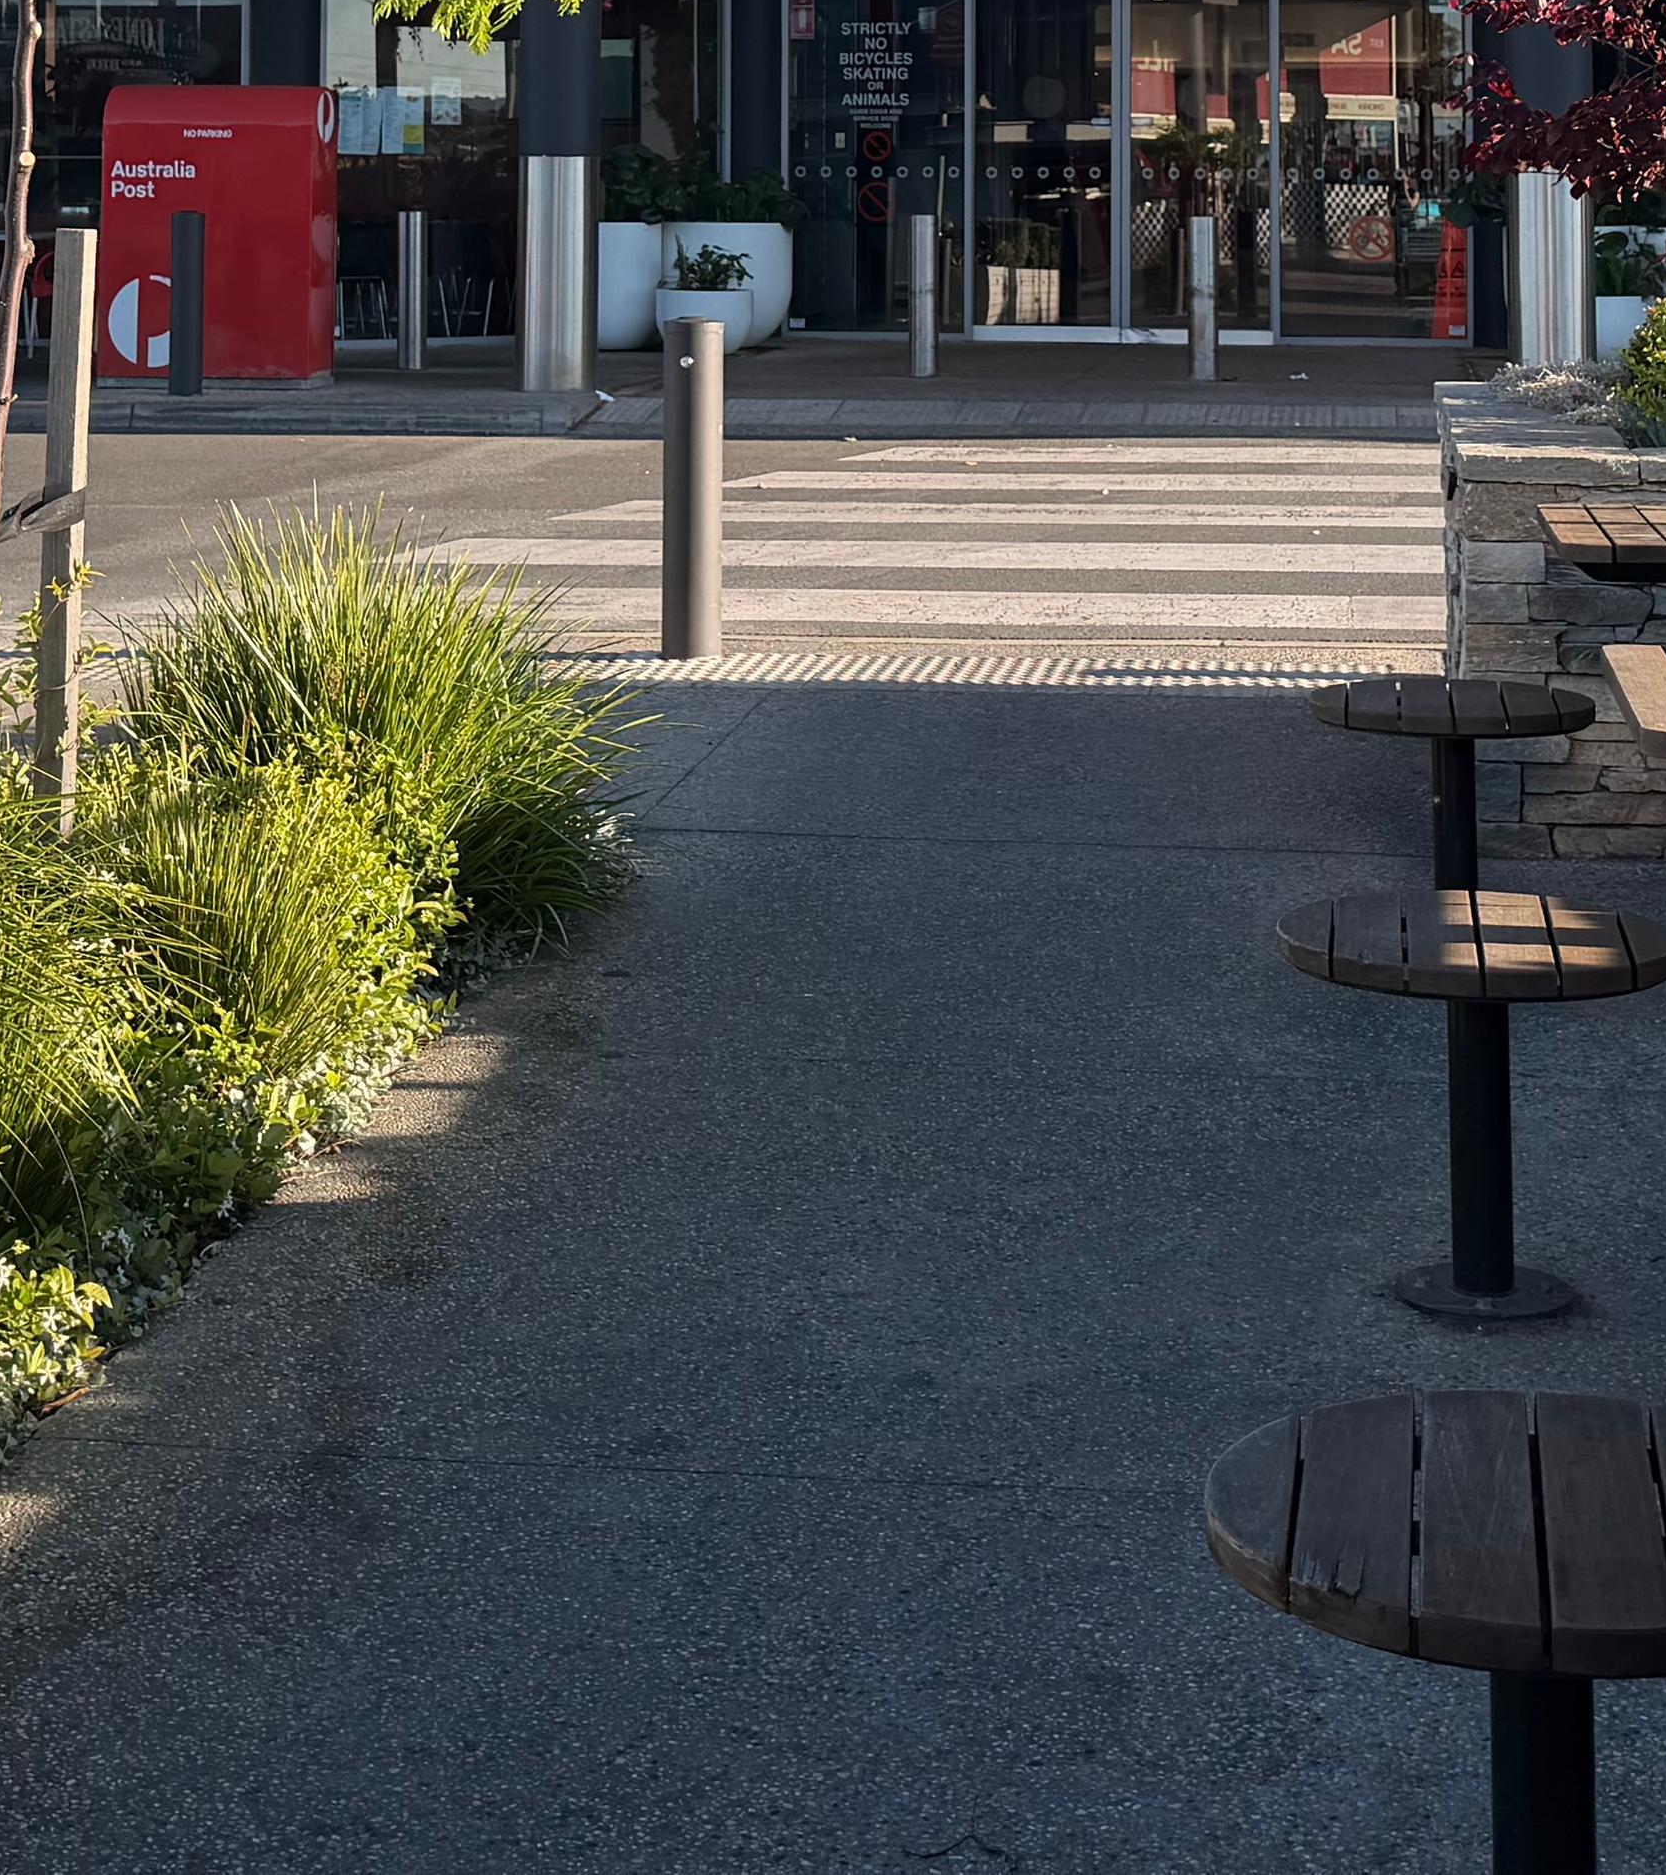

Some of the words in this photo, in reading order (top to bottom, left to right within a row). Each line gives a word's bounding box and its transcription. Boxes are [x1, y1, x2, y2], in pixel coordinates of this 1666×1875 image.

[840, 22, 912, 35] STRICTLY
[864, 37, 888, 50] NO
[839, 52, 914, 65] BICYCLES
[843, 67, 909, 80] SKATING
[867, 81, 885, 91] OR
[841, 93, 910, 106] ANIMALS
[183, 129, 196, 138] NO
[197, 129, 233, 138] PARKING
[111, 160, 196, 178] Australia
[111, 181, 155, 198] Post
